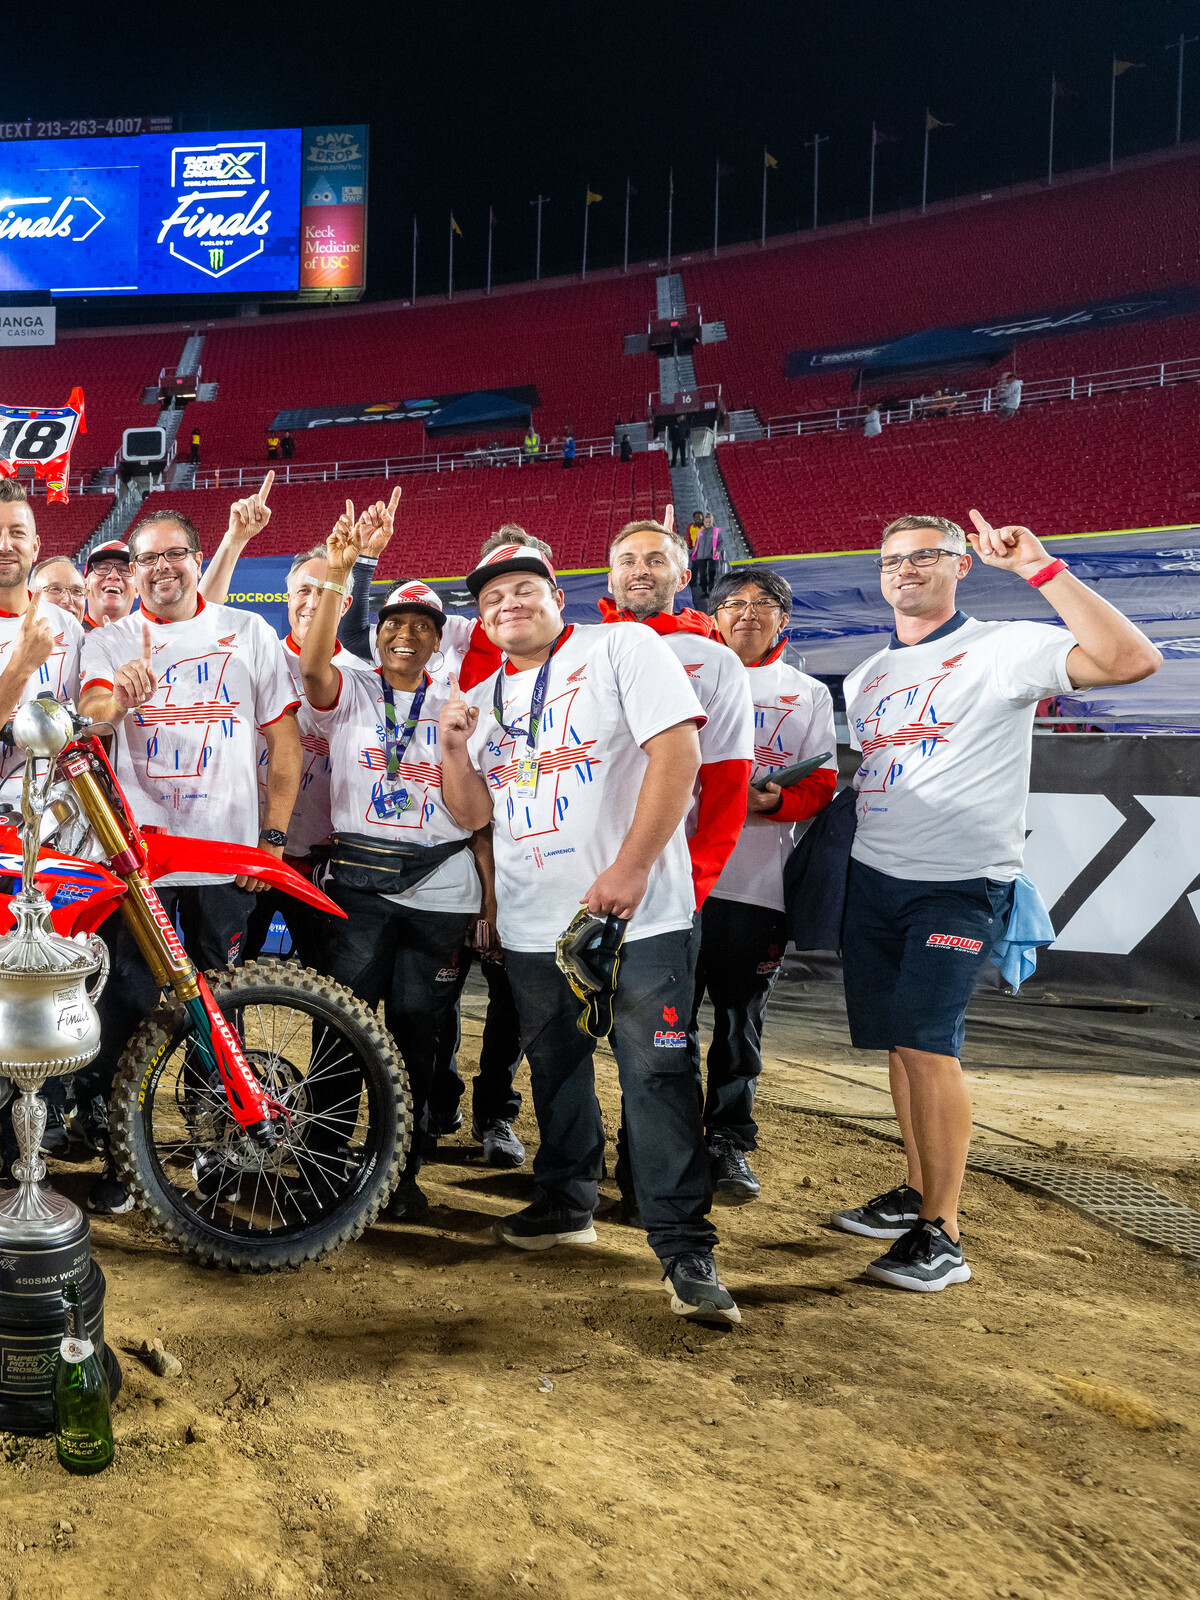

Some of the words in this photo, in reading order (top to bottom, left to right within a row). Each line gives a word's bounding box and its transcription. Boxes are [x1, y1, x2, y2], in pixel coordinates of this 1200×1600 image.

[316, 133, 354, 146] SAVE
[317, 149, 354, 161] DROP
[157, 190, 272, 243] Finals
[305, 225, 335, 238] Keck
[305, 240, 360, 253] Medicine
[304, 256, 318, 270] of
[320, 255, 349, 269] USC
[8, 329, 45, 337] CASINO
[71, 761, 87, 772] GET
[543, 847, 575, 857] LAWRENCE
[57, 883, 93, 898] HRC
[139, 886, 188, 961] SHOWA
[929, 934, 983, 952] SHOWA
[654, 1031, 686, 1044] HRC
[211, 1011, 260, 1094] DUNLOP
[16, 1275, 57, 1285] 450SMX
[60, 1262, 87, 1280] WORLD
